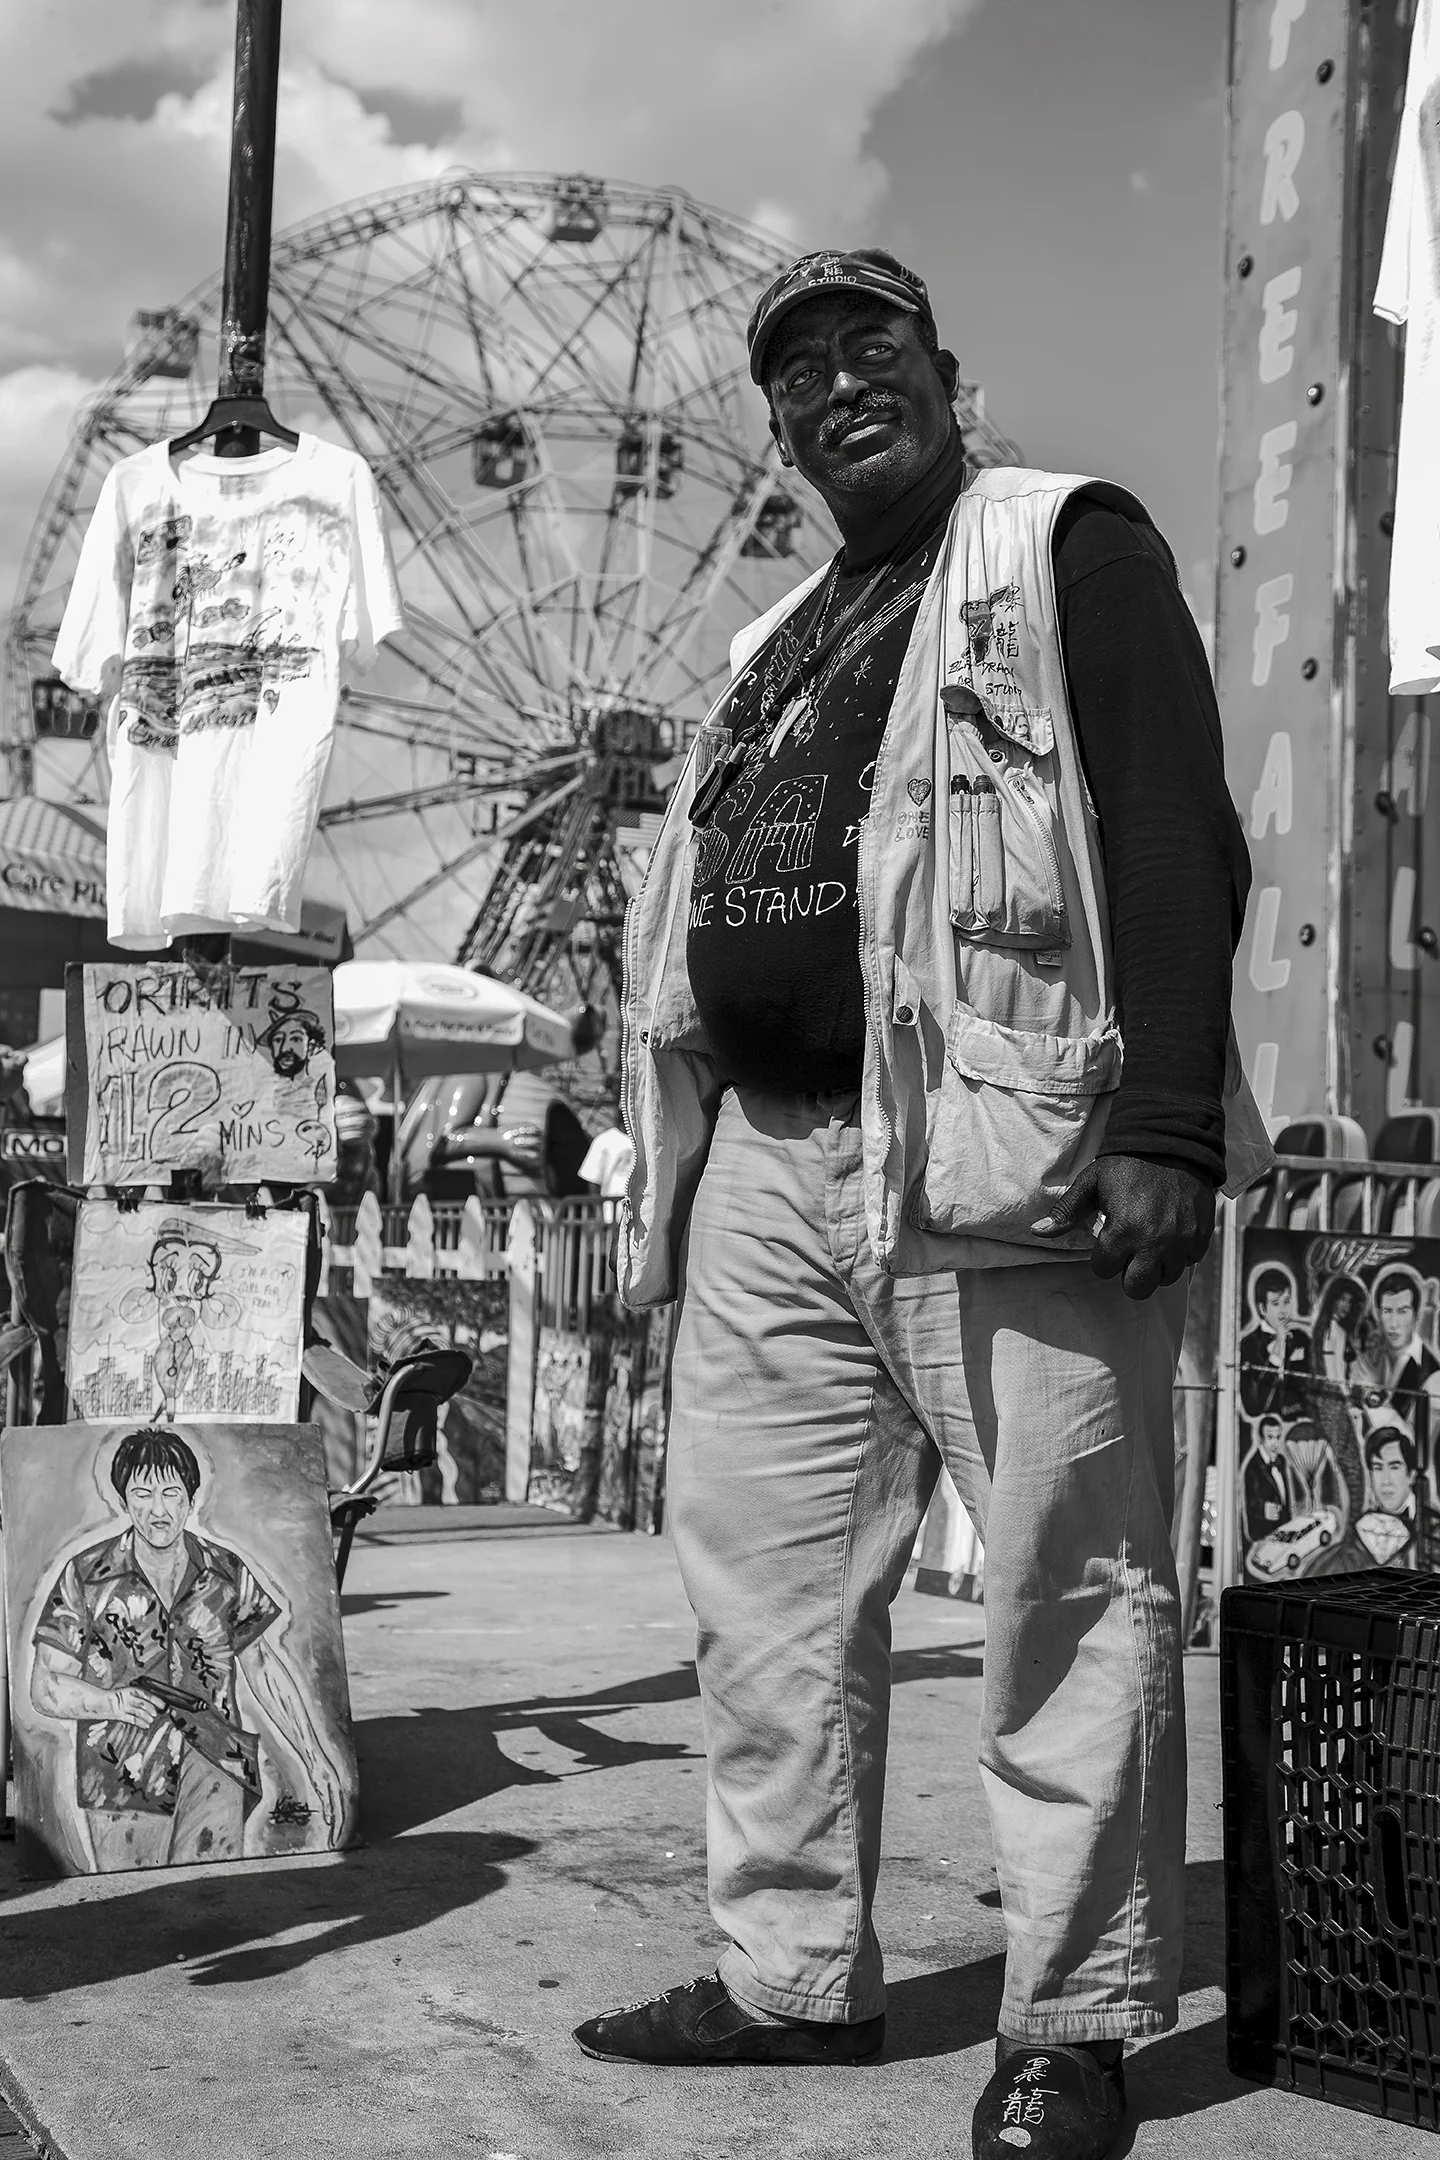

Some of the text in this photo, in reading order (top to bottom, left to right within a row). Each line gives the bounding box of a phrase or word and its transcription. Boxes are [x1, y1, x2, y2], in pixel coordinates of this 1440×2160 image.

[893, 825, 930, 843] LOVE
[897, 811, 930, 826] ONE
[2, 862, 65, 896] Care
[725, 881, 847, 927] STAND
[94, 970, 303, 1016] ORTRAITS
[99, 1023, 201, 1064] RAWN
[218, 1118, 286, 1156] MINS
